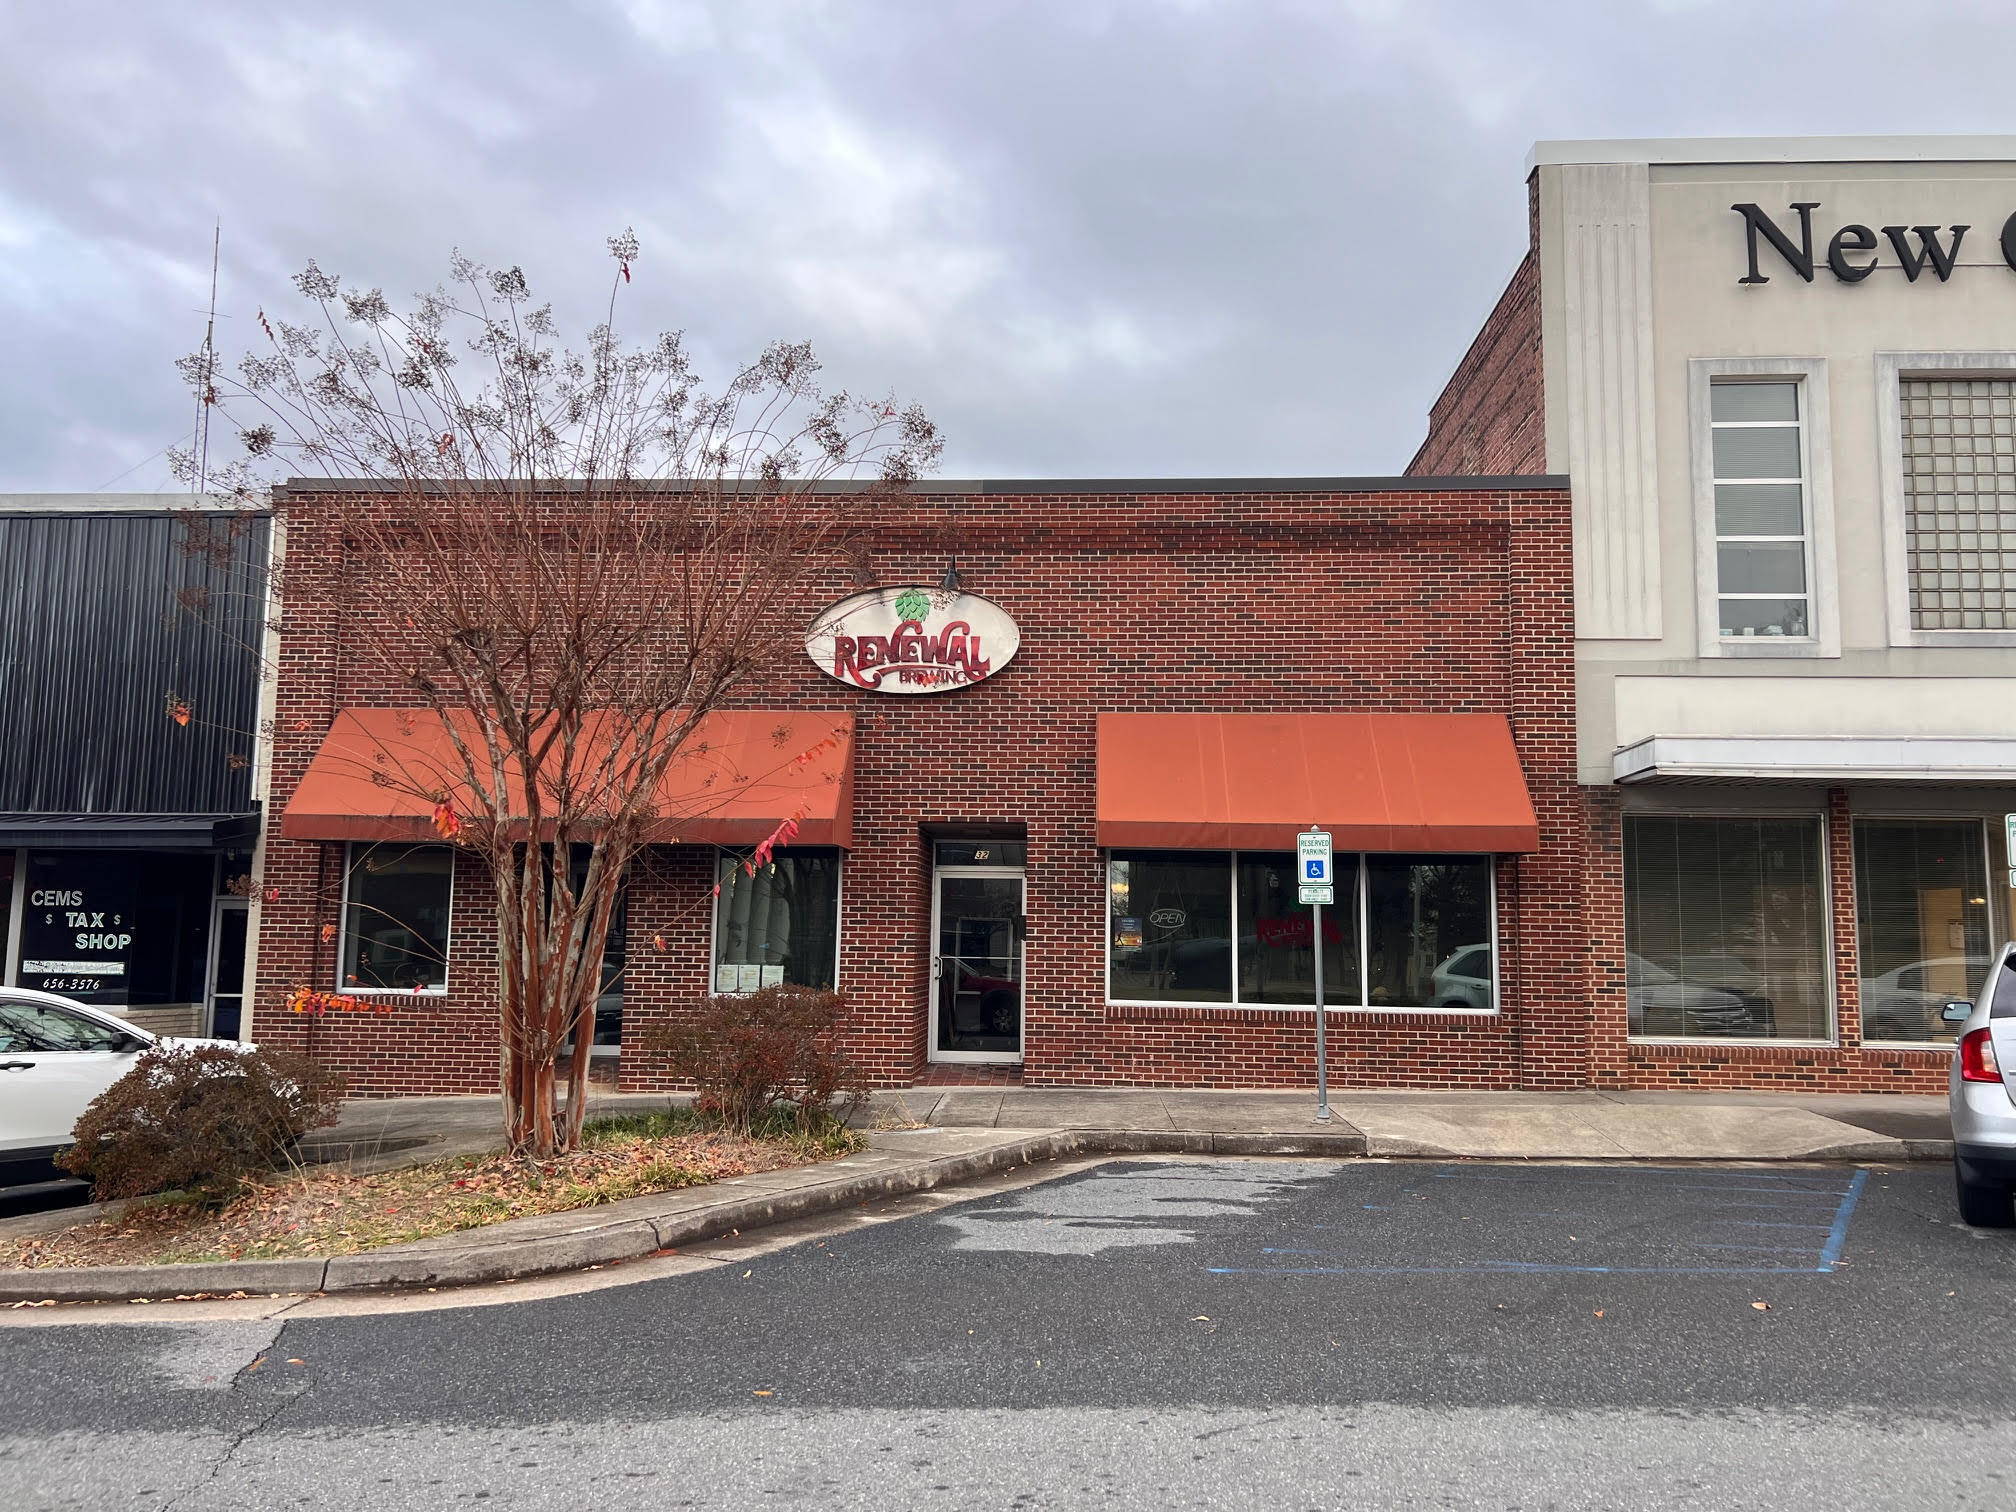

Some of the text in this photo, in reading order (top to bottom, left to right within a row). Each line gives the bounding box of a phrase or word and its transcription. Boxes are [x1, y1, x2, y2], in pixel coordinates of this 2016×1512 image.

[1731, 202, 1971, 283] New
[834, 620, 991, 689] RENEWAL
[976, 851, 989, 859] 32
[31, 890, 83, 906] CEMS
[66, 912, 104, 928] TAX
[1150, 912, 1186, 924] OPEN
[75, 933, 132, 949] SHOP
[43, 978, 100, 989] 656-3576
